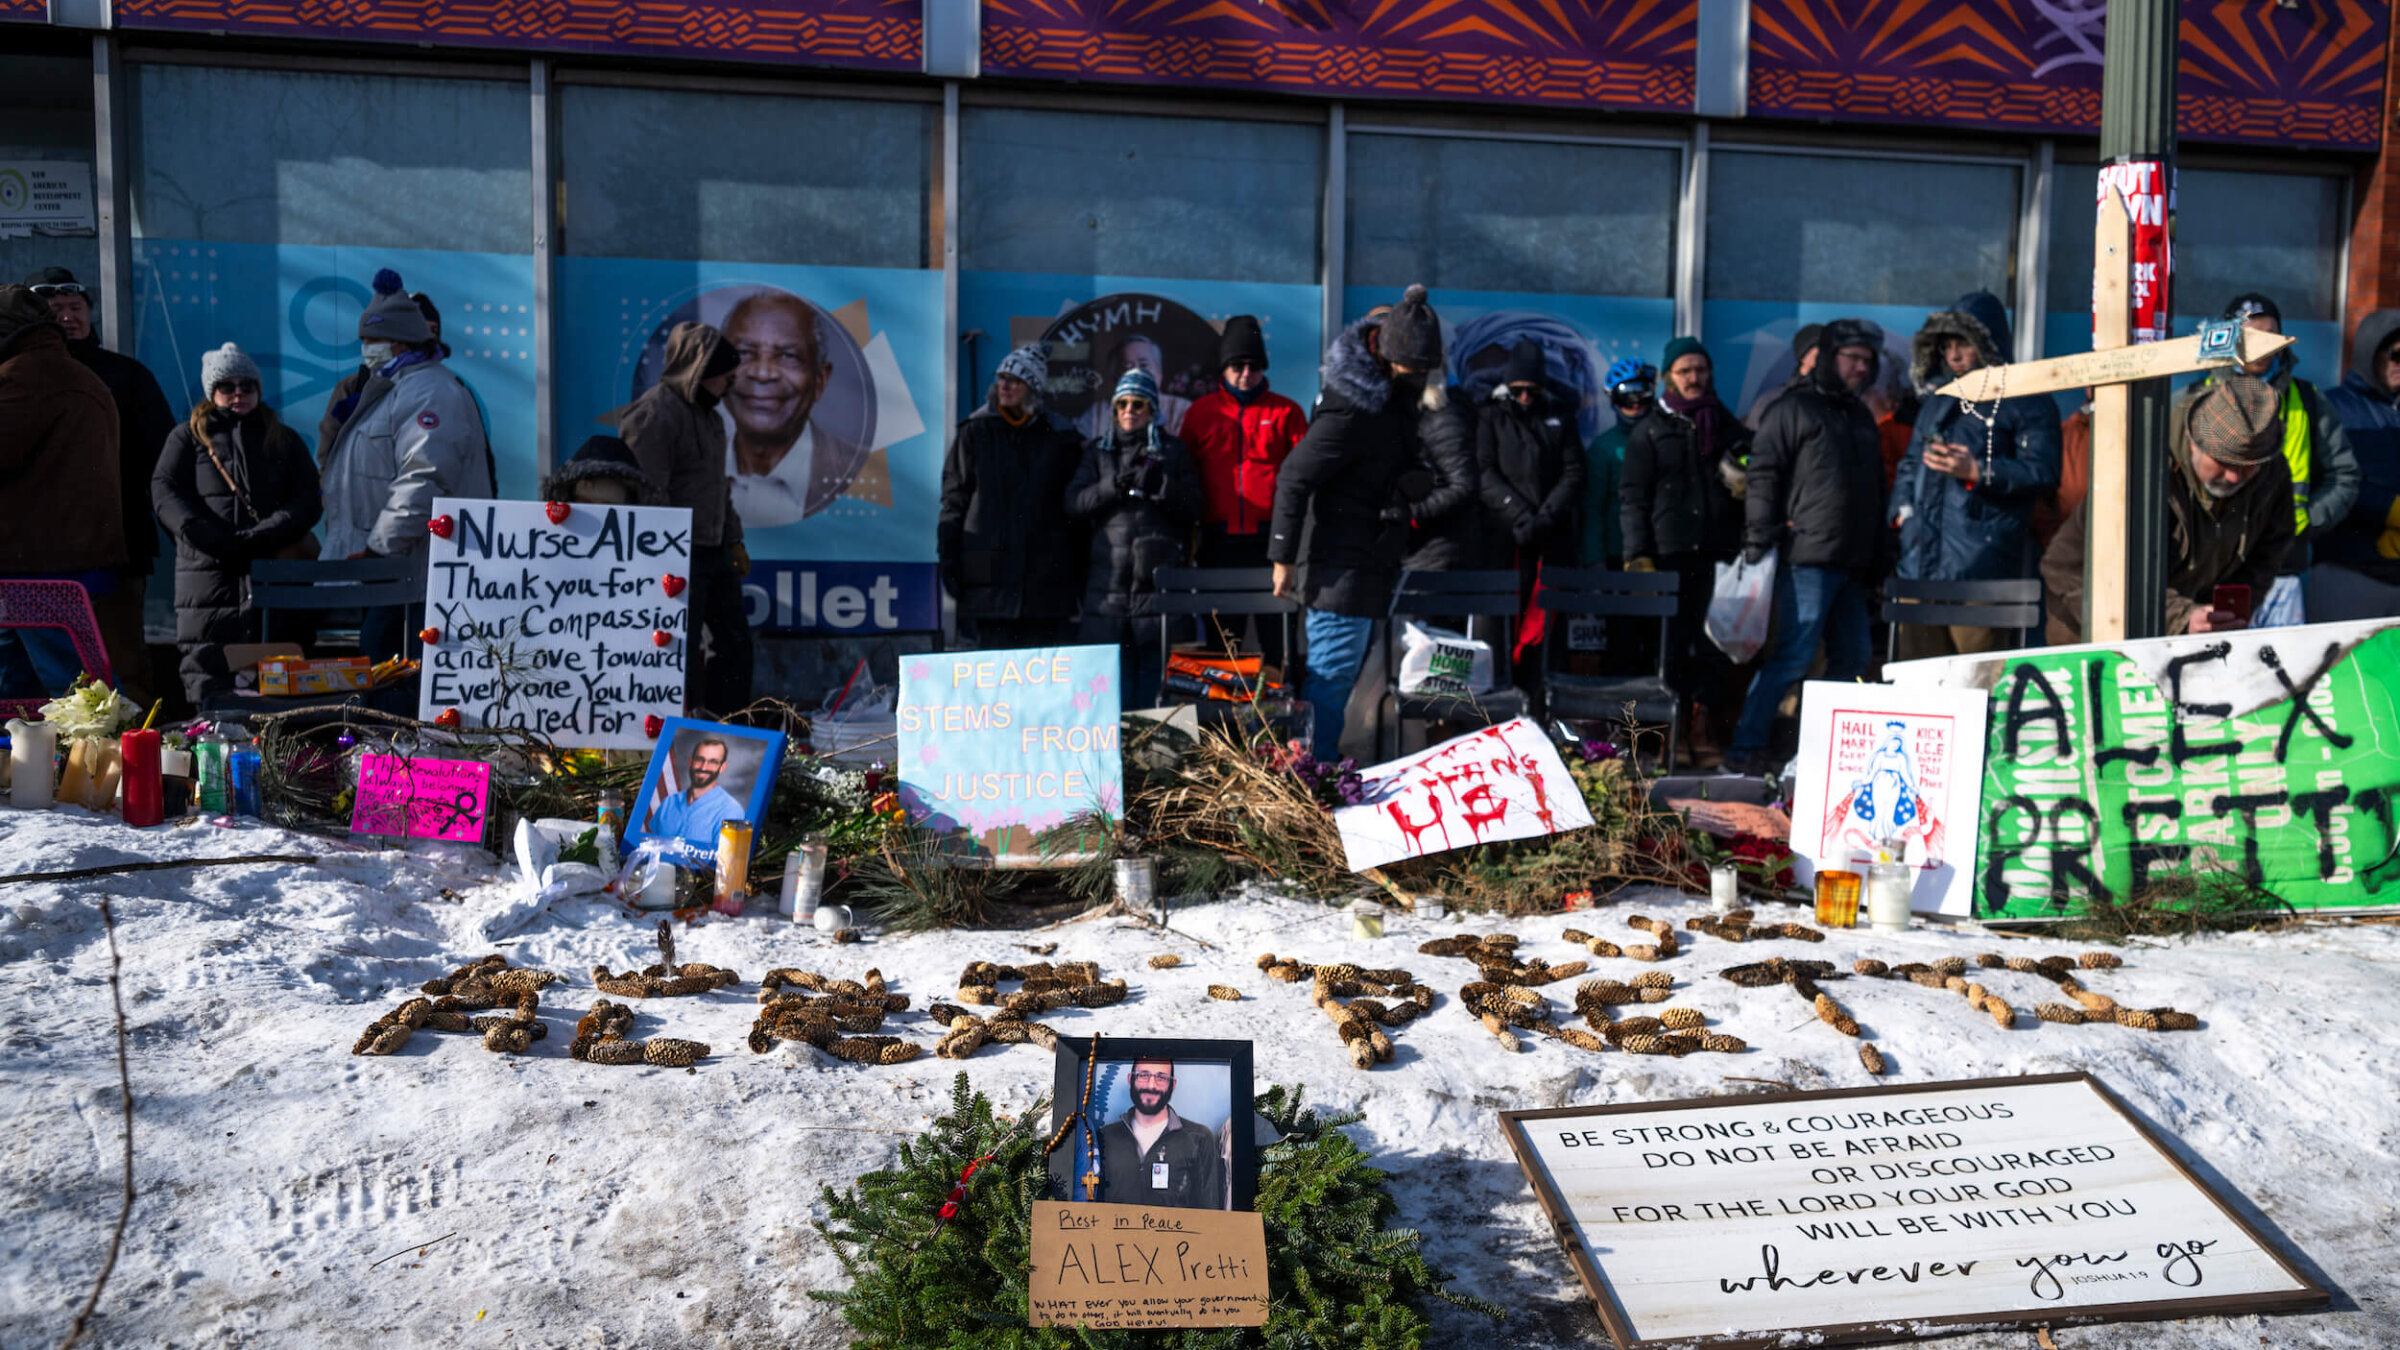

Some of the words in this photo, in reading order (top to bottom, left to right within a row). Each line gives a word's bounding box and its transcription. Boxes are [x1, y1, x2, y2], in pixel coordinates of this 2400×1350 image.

[33, 192, 81, 200] DEVELOPMENT
[34, 203, 61, 211] CENTER
[457, 506, 584, 560] Nurse
[433, 561, 540, 600] Thank
[544, 579, 599, 609] you
[741, 570, 899, 629] ollet
[434, 601, 515, 643] Your
[520, 604, 688, 641] Compassion
[434, 643, 494, 670] and
[590, 640, 684, 672] toward
[953, 656, 1072, 689] PEACE
[430, 673, 577, 710] Everyone
[580, 673, 625, 702] You
[628, 673, 683, 704] have
[2003, 640, 2354, 779] ALEX
[481, 696, 583, 735] Cared
[901, 702, 1012, 732] STEMS
[1841, 720, 1876, 737] HAIL
[1916, 727, 1945, 741] KICK
[1021, 724, 1118, 753] FROM
[1840, 738, 1876, 751] MARY
[933, 770, 1084, 801] JUSTICE
[1559, 1130, 1604, 1148] BE
[1612, 1121, 1755, 1146] STRONG
[1761, 1120, 1780, 1135] &
[1786, 1102, 2014, 1134] COURAGEOUS
[1641, 1151, 1696, 1169] DO
[1705, 1144, 1777, 1166] NOT
[1788, 1141, 1836, 1160] BE
[1844, 1131, 1963, 1158] AFRAID
[1811, 1166, 1865, 1185] OR
[1869, 1144, 2116, 1181] DISCOURAGED
[1611, 1203, 1689, 1224] FOR
[1693, 1199, 1774, 1220] THE
[1776, 1193, 1878, 1215] LORD
[1882, 1183, 1991, 1207] YOUR
[1993, 1176, 2073, 1198] GOD
[1058, 1208, 1100, 1229] Rest
[1113, 1214, 1129, 1229] in
[1141, 1212, 1183, 1231] Peace
[1796, 1219, 1893, 1241] WILL
[1897, 1216, 1948, 1236] BE
[1949, 1205, 2054, 1230] WITH
[2054, 1197, 2138, 1222] YOU
[1058, 1242, 1164, 1286] ALEX
[1176, 1240, 1249, 1282] Pretti
[1719, 1243, 1981, 1295] wherever
[2015, 1248, 2129, 1301] you
[2156, 1238, 2220, 1288] go
[2071, 1273, 2129, 1286] JOSHUA
[2129, 1270, 2149, 1281] 1:9
[1142, 1297, 1169, 1306] allow
[1174, 1297, 1196, 1308] your
[1199, 1293, 1258, 1306] government
